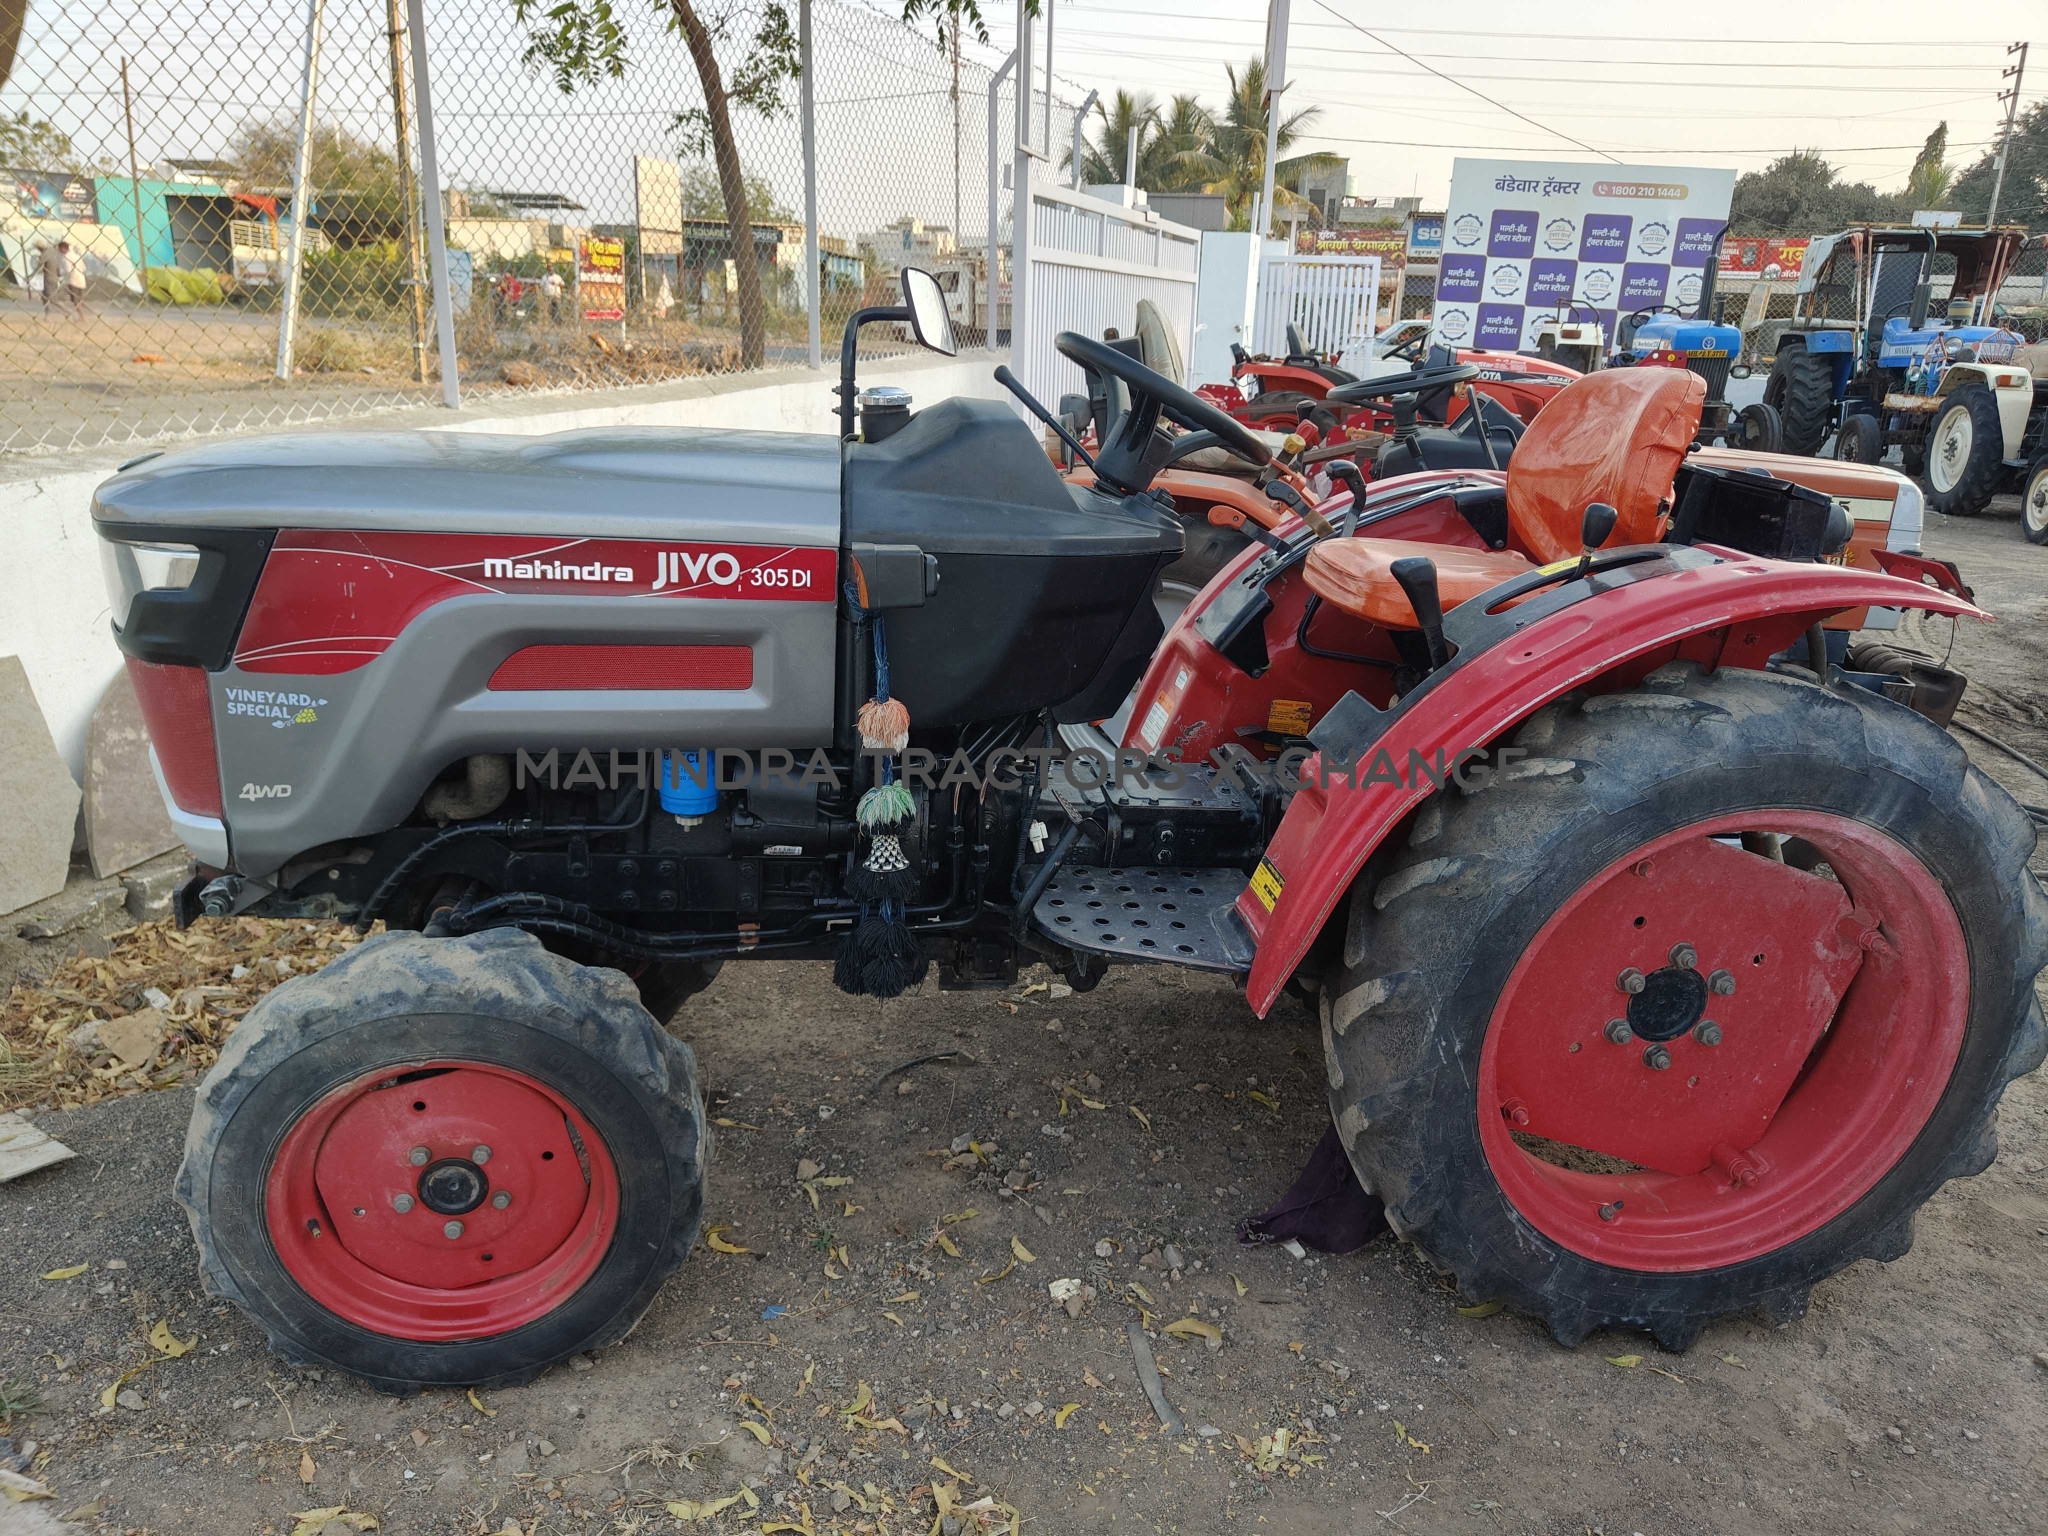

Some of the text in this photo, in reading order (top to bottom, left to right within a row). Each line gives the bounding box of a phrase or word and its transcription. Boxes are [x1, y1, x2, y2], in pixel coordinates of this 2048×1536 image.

[1494, 174, 1581, 197] बंडेवार ट्रॅक्टर
[1611, 185, 1681, 197] 1800 210 1444
[483, 557, 634, 583] Mahindra
[652, 551, 741, 590] JIVO
[750, 567, 789, 587] 305
[225, 687, 312, 706] VINEYARD
[227, 702, 291, 719] SPECIAL
[239, 783, 292, 801] 4WD
